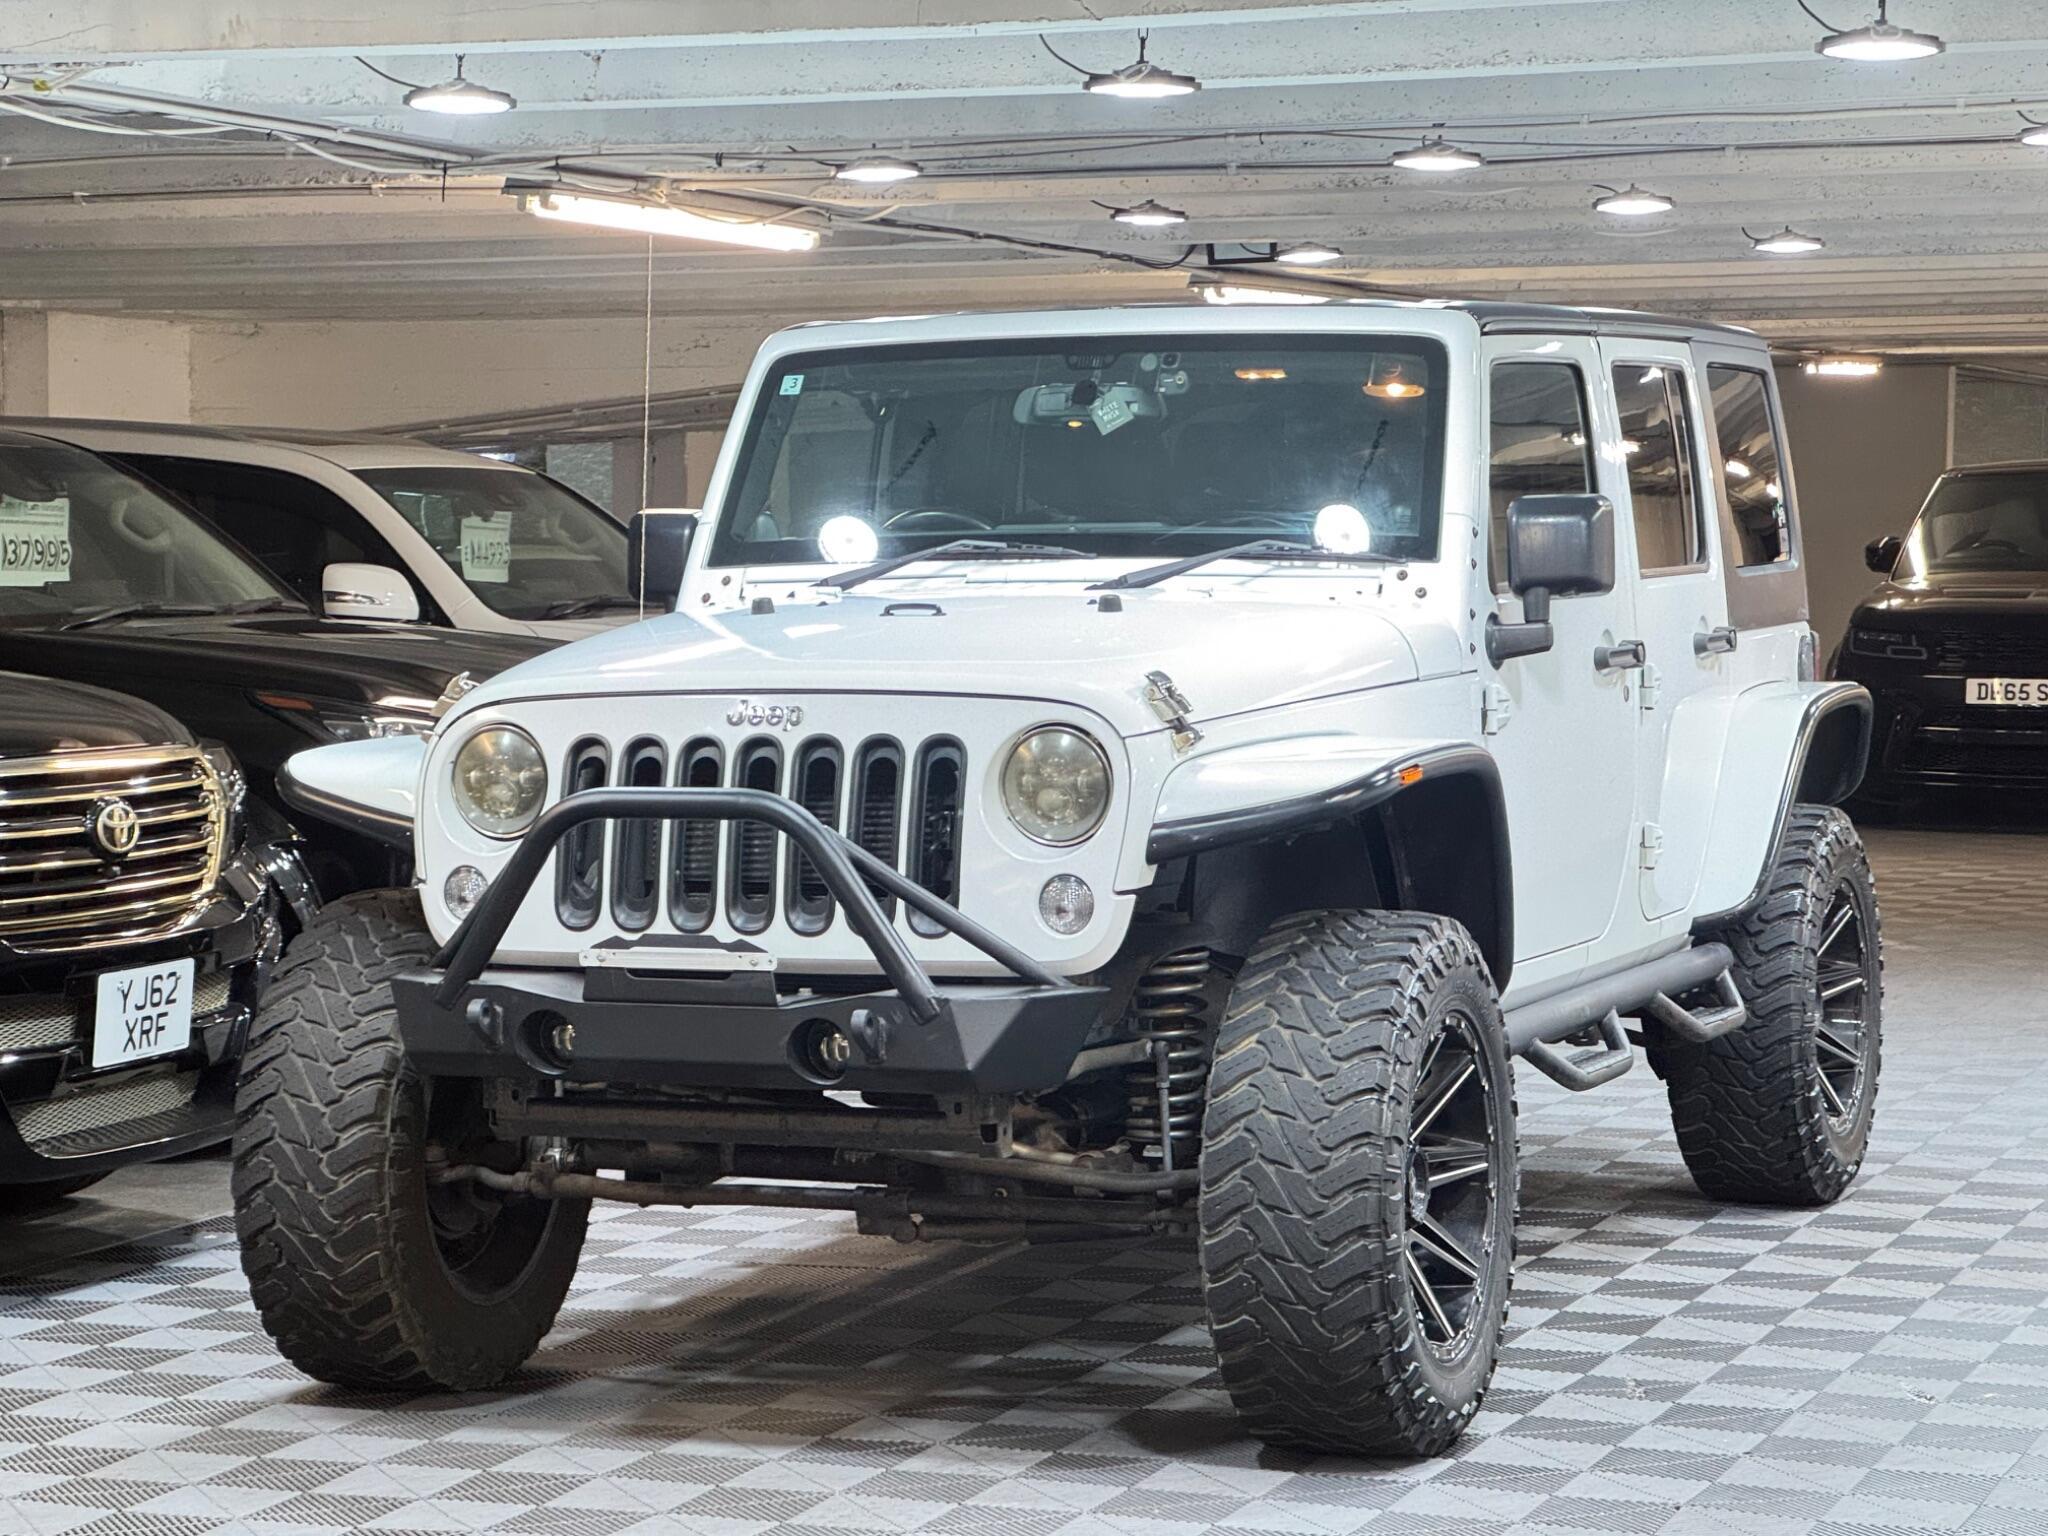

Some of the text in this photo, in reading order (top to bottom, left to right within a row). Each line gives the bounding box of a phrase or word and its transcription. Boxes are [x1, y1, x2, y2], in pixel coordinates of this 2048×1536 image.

[7, 538, 71, 567] 37995
[726, 699, 804, 732] Jeep
[120, 971, 178, 1014] YJ62
[122, 1011, 169, 1053] XRF
